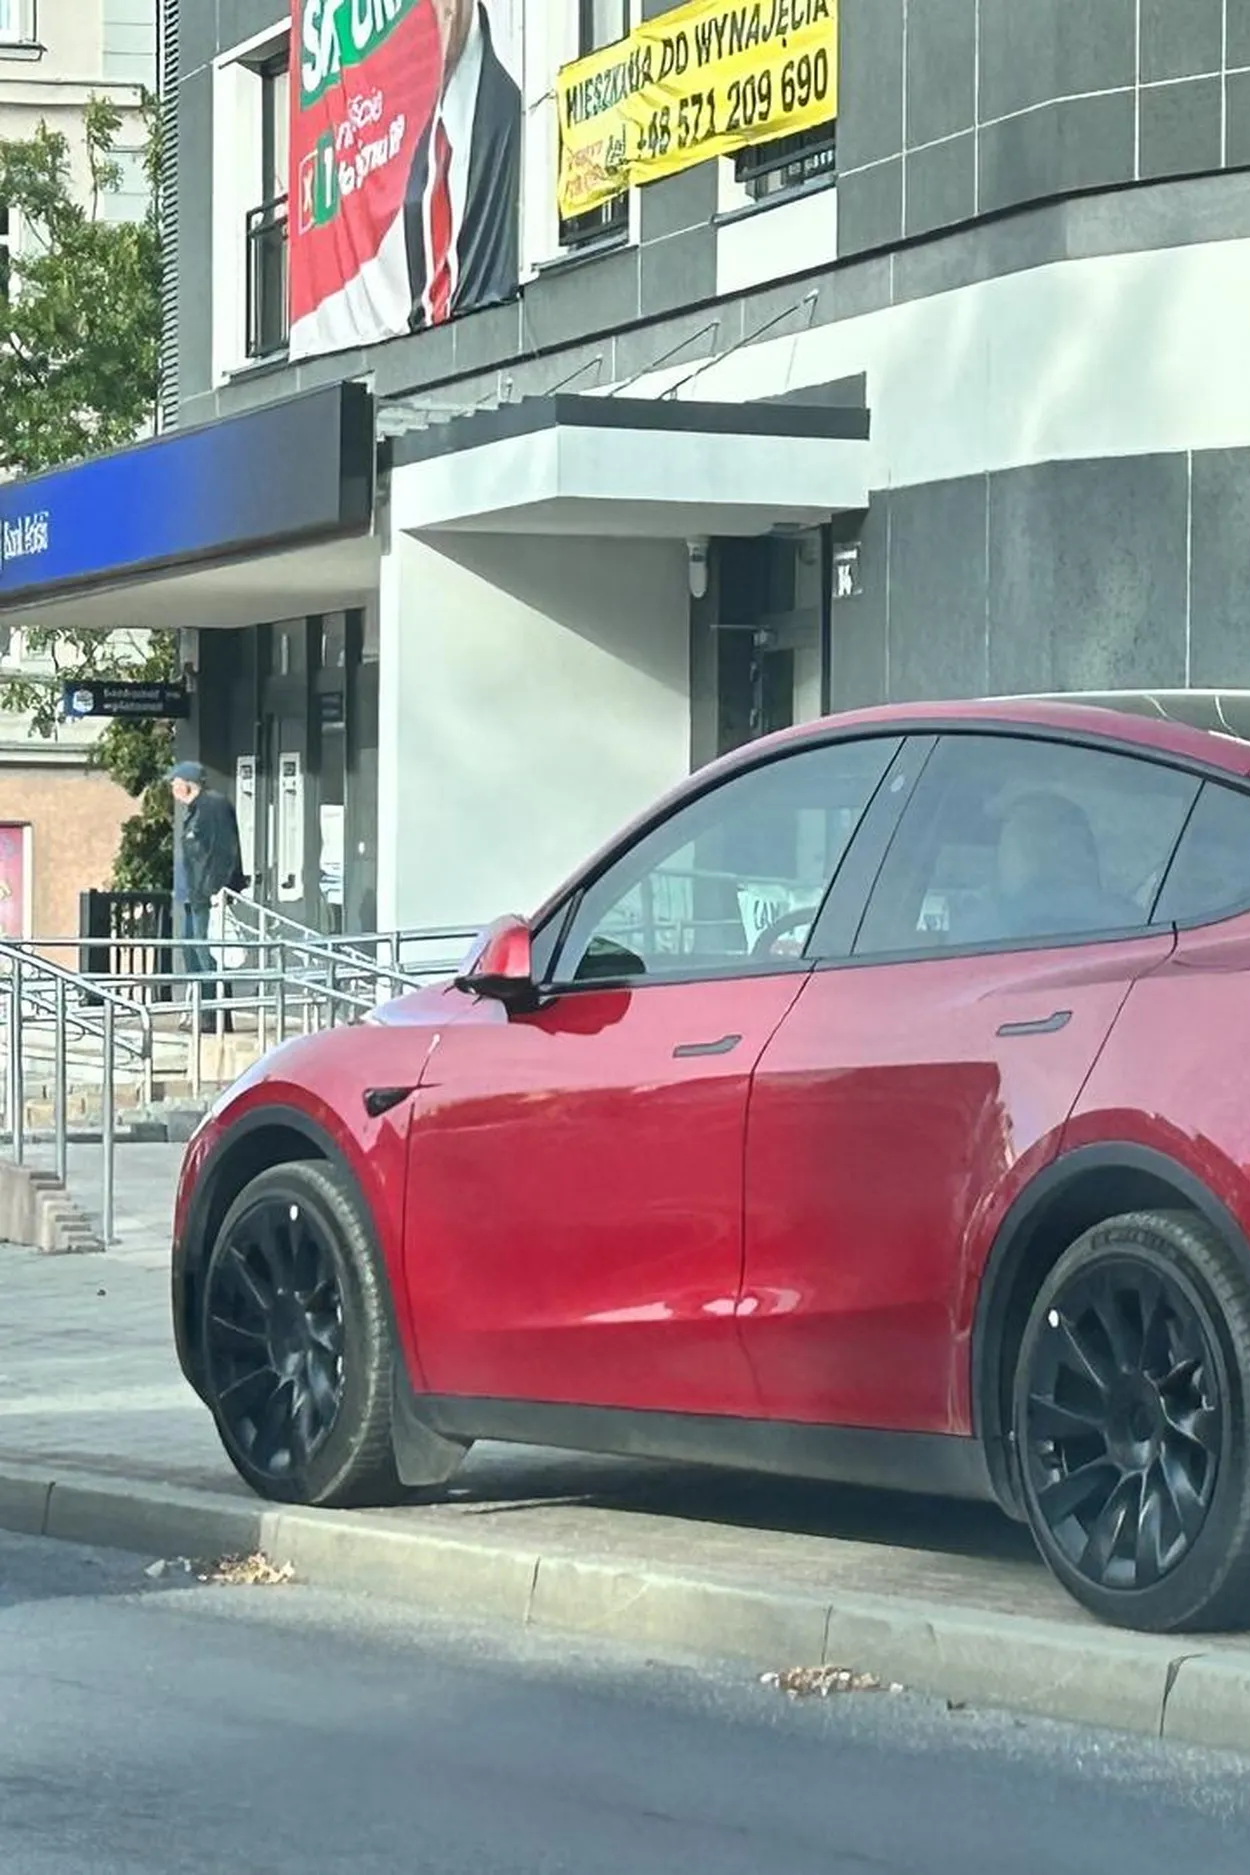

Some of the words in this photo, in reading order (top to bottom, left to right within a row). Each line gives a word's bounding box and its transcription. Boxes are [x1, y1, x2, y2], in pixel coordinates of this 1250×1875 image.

[658, 31, 689, 81] DO
[678, 88, 716, 149] 571
[726, 69, 772, 131] 209
[781, 48, 828, 112] 690
